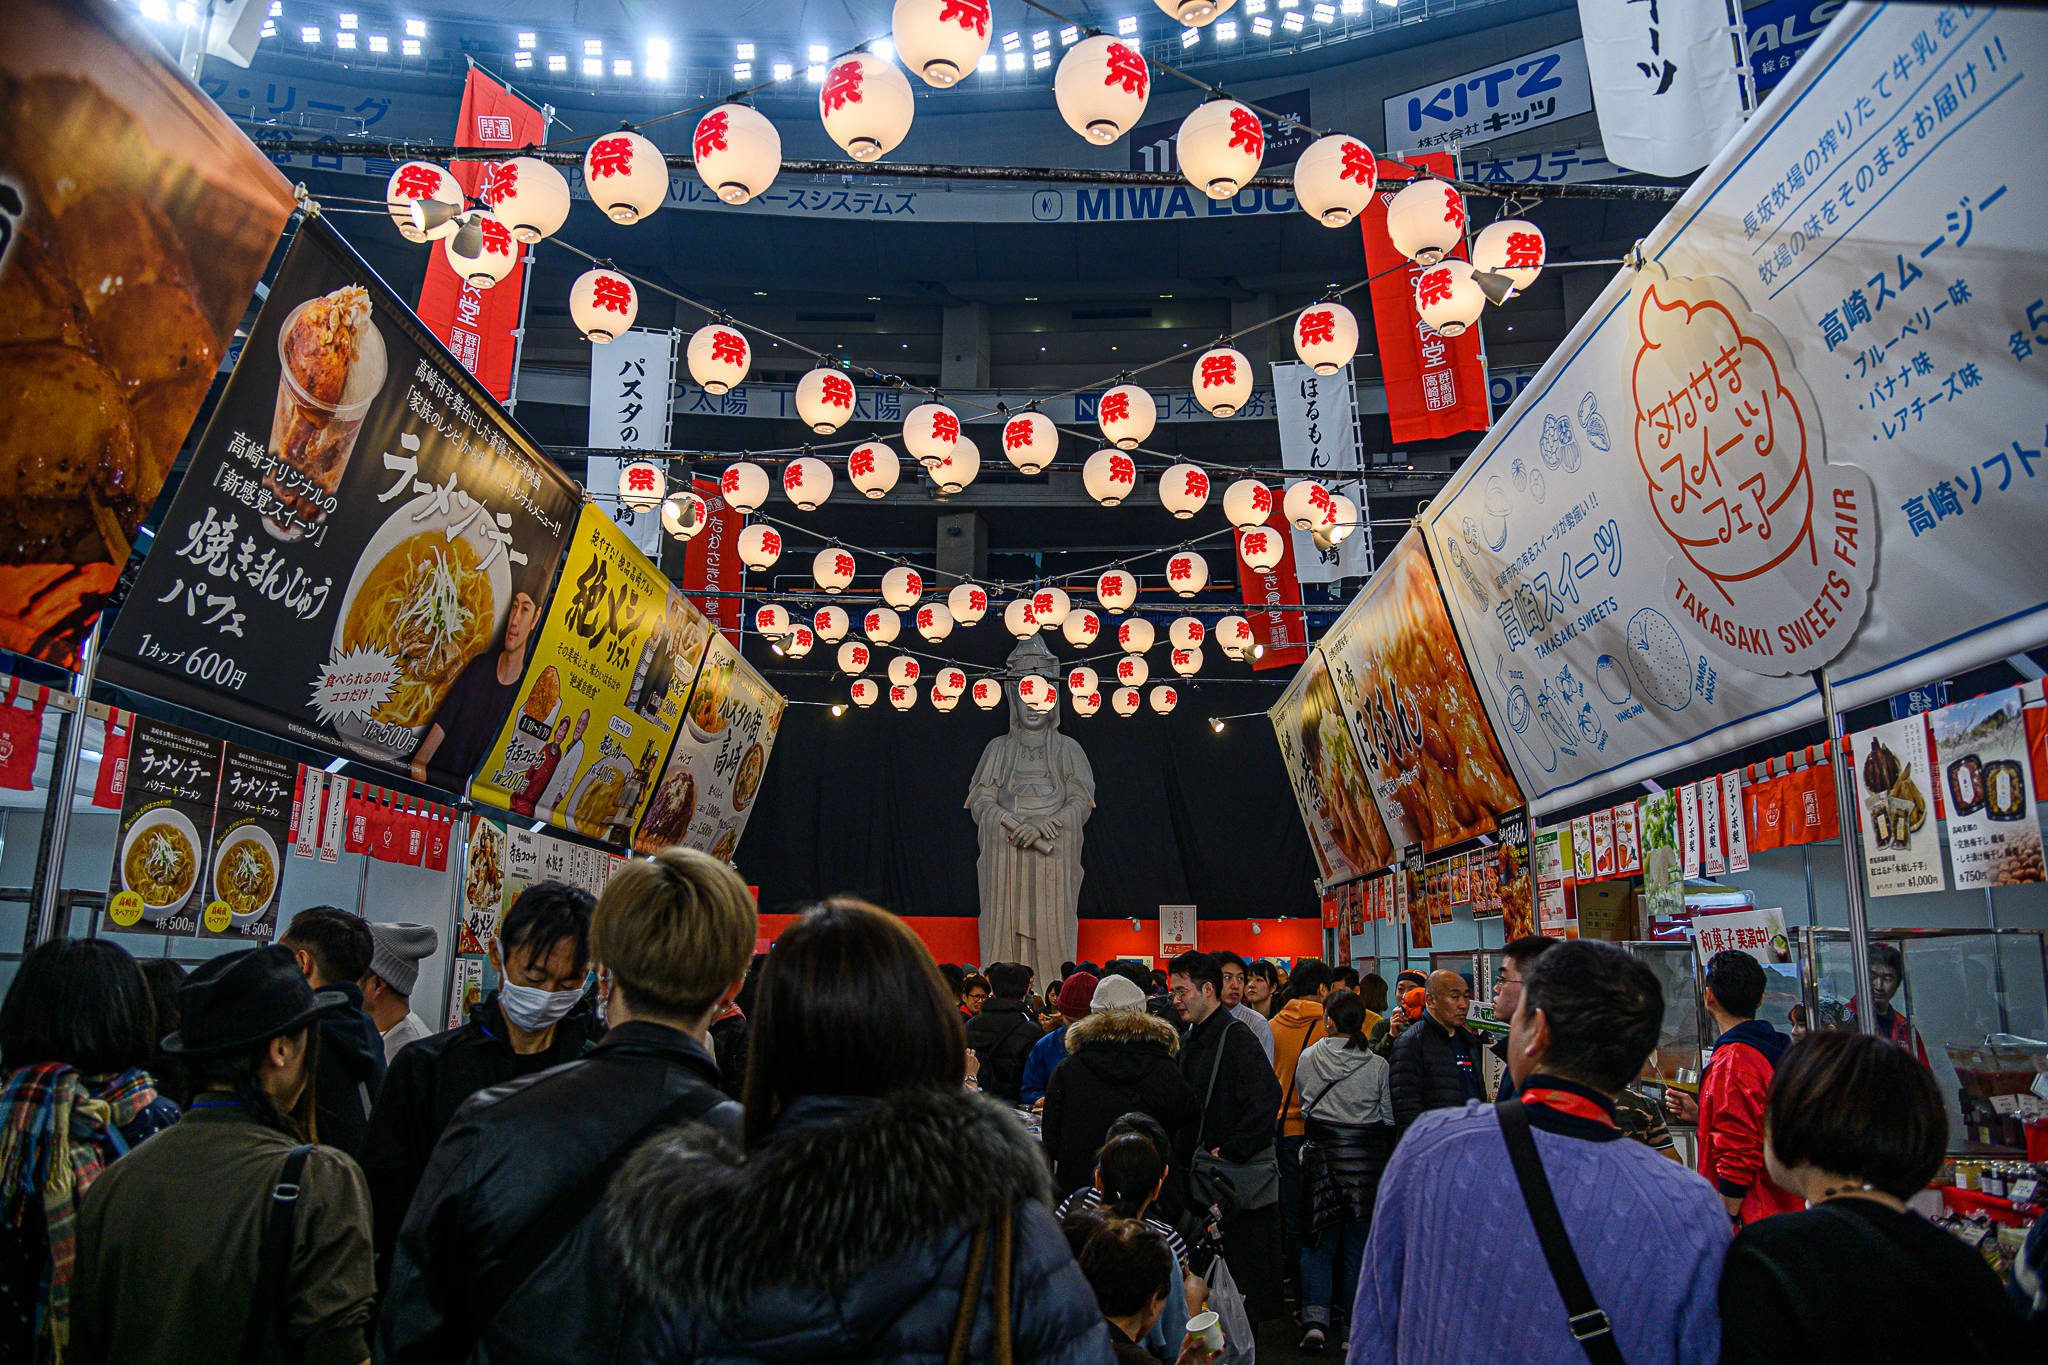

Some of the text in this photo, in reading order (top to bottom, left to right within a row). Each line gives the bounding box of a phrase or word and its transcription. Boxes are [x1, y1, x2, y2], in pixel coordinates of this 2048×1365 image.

[939, 0, 990, 38] 祭
[1104, 42, 1148, 100] 祭
[1761, 48, 1804, 76] 綜合
[822, 61, 863, 118] 祭
[1408, 53, 1563, 132] KITZ
[694, 111, 729, 164] 祭
[1228, 107, 1265, 161] 祭
[589, 137, 633, 182] 祭
[1340, 142, 1376, 190] 祭
[1460, 149, 1640, 184] 日本ステー
[394, 164, 442, 201] 祭
[1076, 185, 1301, 221] MIWA LOC
[1504, 231, 1543, 271] 祭
[1818, 185, 2008, 353] 高崎スムージー
[592, 275, 632, 316] 祭
[1418, 267, 1453, 310] 祭
[1299, 310, 1336, 348] 祭
[2007, 298, 2048, 363] 各5
[711, 330, 747, 368] 祭
[1201, 355, 1237, 389] 祭
[821, 374, 853, 410] 祭
[1100, 392, 1130, 427] 祭
[931, 411, 960, 445] 祭
[1005, 419, 1034, 451] 祭
[849, 448, 875, 479] 祭
[1660, 389, 1775, 515] スイーツ
[227, 430, 338, 515] 高崎オリジナルの
[628, 467, 656, 491] 祭
[722, 470, 740, 494] 祭
[783, 463, 803, 492] 祭
[1109, 455, 1135, 485] 祭
[1184, 470, 1209, 500] 祭
[1901, 424, 2048, 538] 高崎ソフト
[1252, 486, 1272, 513] 祭
[1309, 485, 1330, 513] 祭
[1702, 471, 1772, 545] フェア
[760, 530, 781, 557] 祭
[1243, 532, 1268, 556] 祭
[175, 506, 333, 620] 焼きまんじゅう
[834, 553, 855, 579] 祭
[1169, 558, 1192, 581] 祭
[1674, 487, 1859, 657] TAKASAKI SWEETS FAIR
[905, 572, 923, 597] 祭
[1100, 575, 1123, 598] 祭
[1495, 518, 1623, 652] 高崎スイーツ
[158, 578, 246, 638] パフェ
[564, 552, 648, 651] 絶メシ
[969, 589, 987, 612] 祭
[1033, 593, 1054, 617] 祭
[757, 609, 776, 628] 祭
[815, 611, 832, 632] 祭
[864, 613, 881, 633] 祭
[917, 608, 934, 630] 祭
[1082, 614, 1100, 635] 祭
[1188, 621, 1204, 641] 祭
[1235, 621, 1250, 640] 祭
[1534, 596, 1619, 661] TAKASAKI SWEETS
[795, 628, 813, 648] 祭
[137, 633, 248, 691] 1カップ 600円
[605, 640, 631, 671] リスト
[851, 646, 869, 666] 祭
[904, 661, 920, 679] 祭
[1118, 661, 1134, 679] 祭
[1172, 648, 1190, 666] 祭
[324, 671, 391, 689] 食べられるのは
[851, 683, 865, 698] 祭
[949, 671, 965, 689] 祭
[973, 683, 988, 700] 祭
[1019, 679, 1034, 696] 祭
[1069, 672, 1085, 689] 祭
[1694, 655, 1709, 698] JUMBO
[1704, 667, 1718, 705] NASHI
[890, 686, 905, 702] 祭
[1087, 692, 1101, 708] 祭
[1127, 691, 1140, 707] 祭
[1165, 689, 1177, 705] 祭
[378, 721, 419, 753] 500円
[1353, 676, 1424, 776] ほるもん
[140, 748, 211, 784] ラーメン・テー
[713, 727, 743, 786] 高崎
[229, 771, 289, 803] ラーメン・テー
[1727, 778, 1741, 844] ジャンボ梨
[168, 916, 195, 932] 500円
[251, 922, 274, 938] 500円
